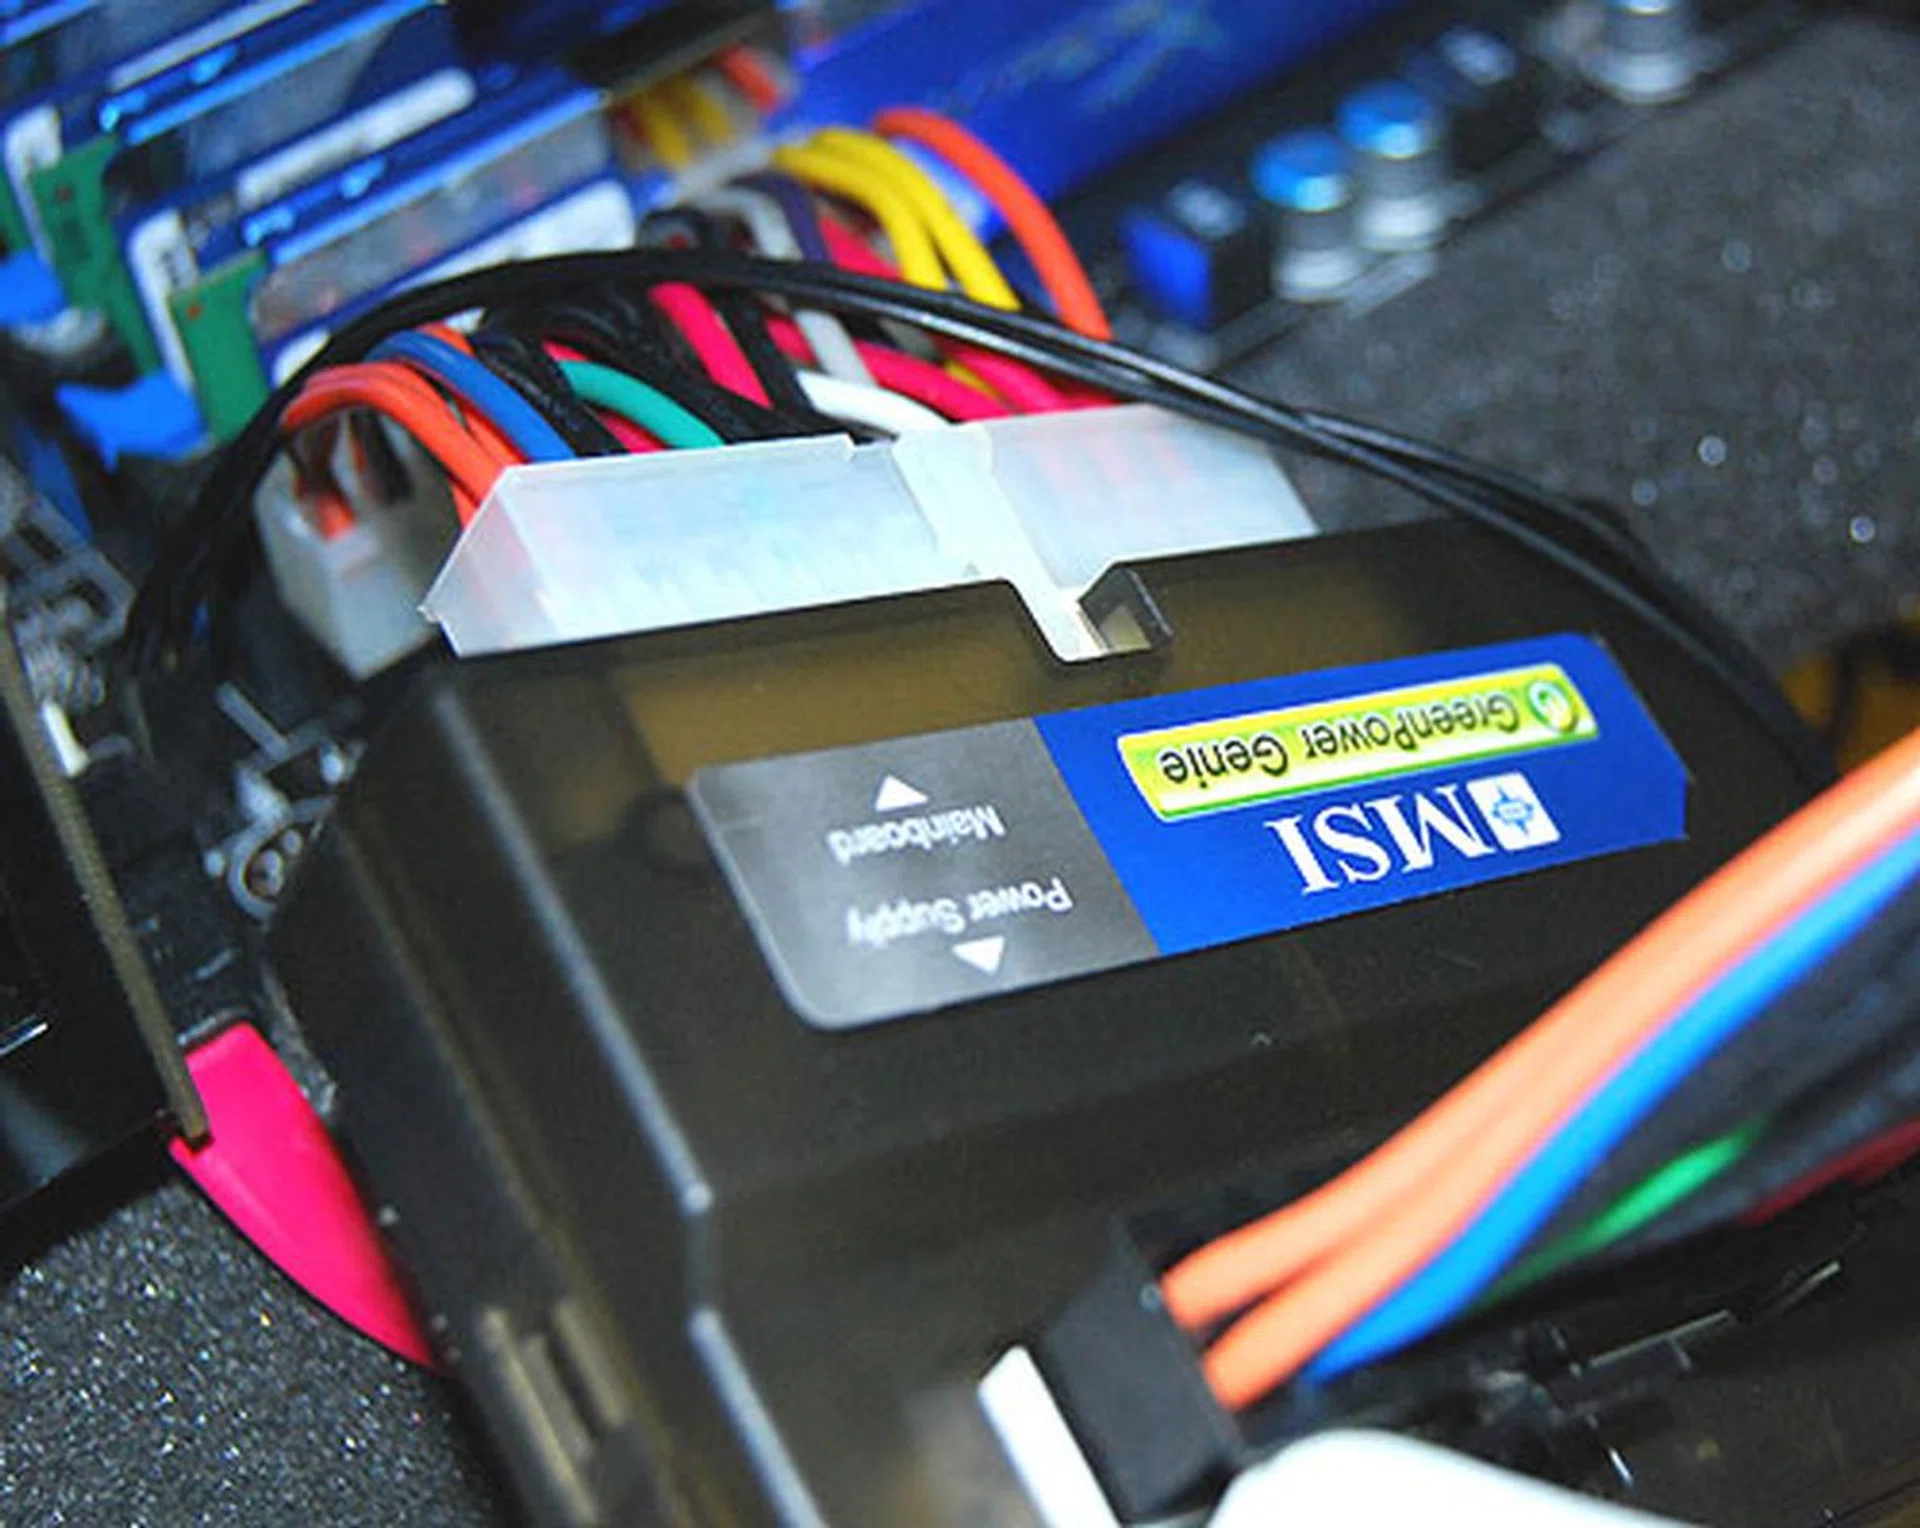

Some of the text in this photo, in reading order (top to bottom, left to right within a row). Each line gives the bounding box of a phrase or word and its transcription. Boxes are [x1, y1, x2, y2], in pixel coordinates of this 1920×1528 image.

[1160, 693, 1519, 788] GreenPower Genie
[827, 804, 1006, 865] Mainboard
[1264, 783, 1497, 896] MSI
[846, 876, 1074, 947] Power Supply
